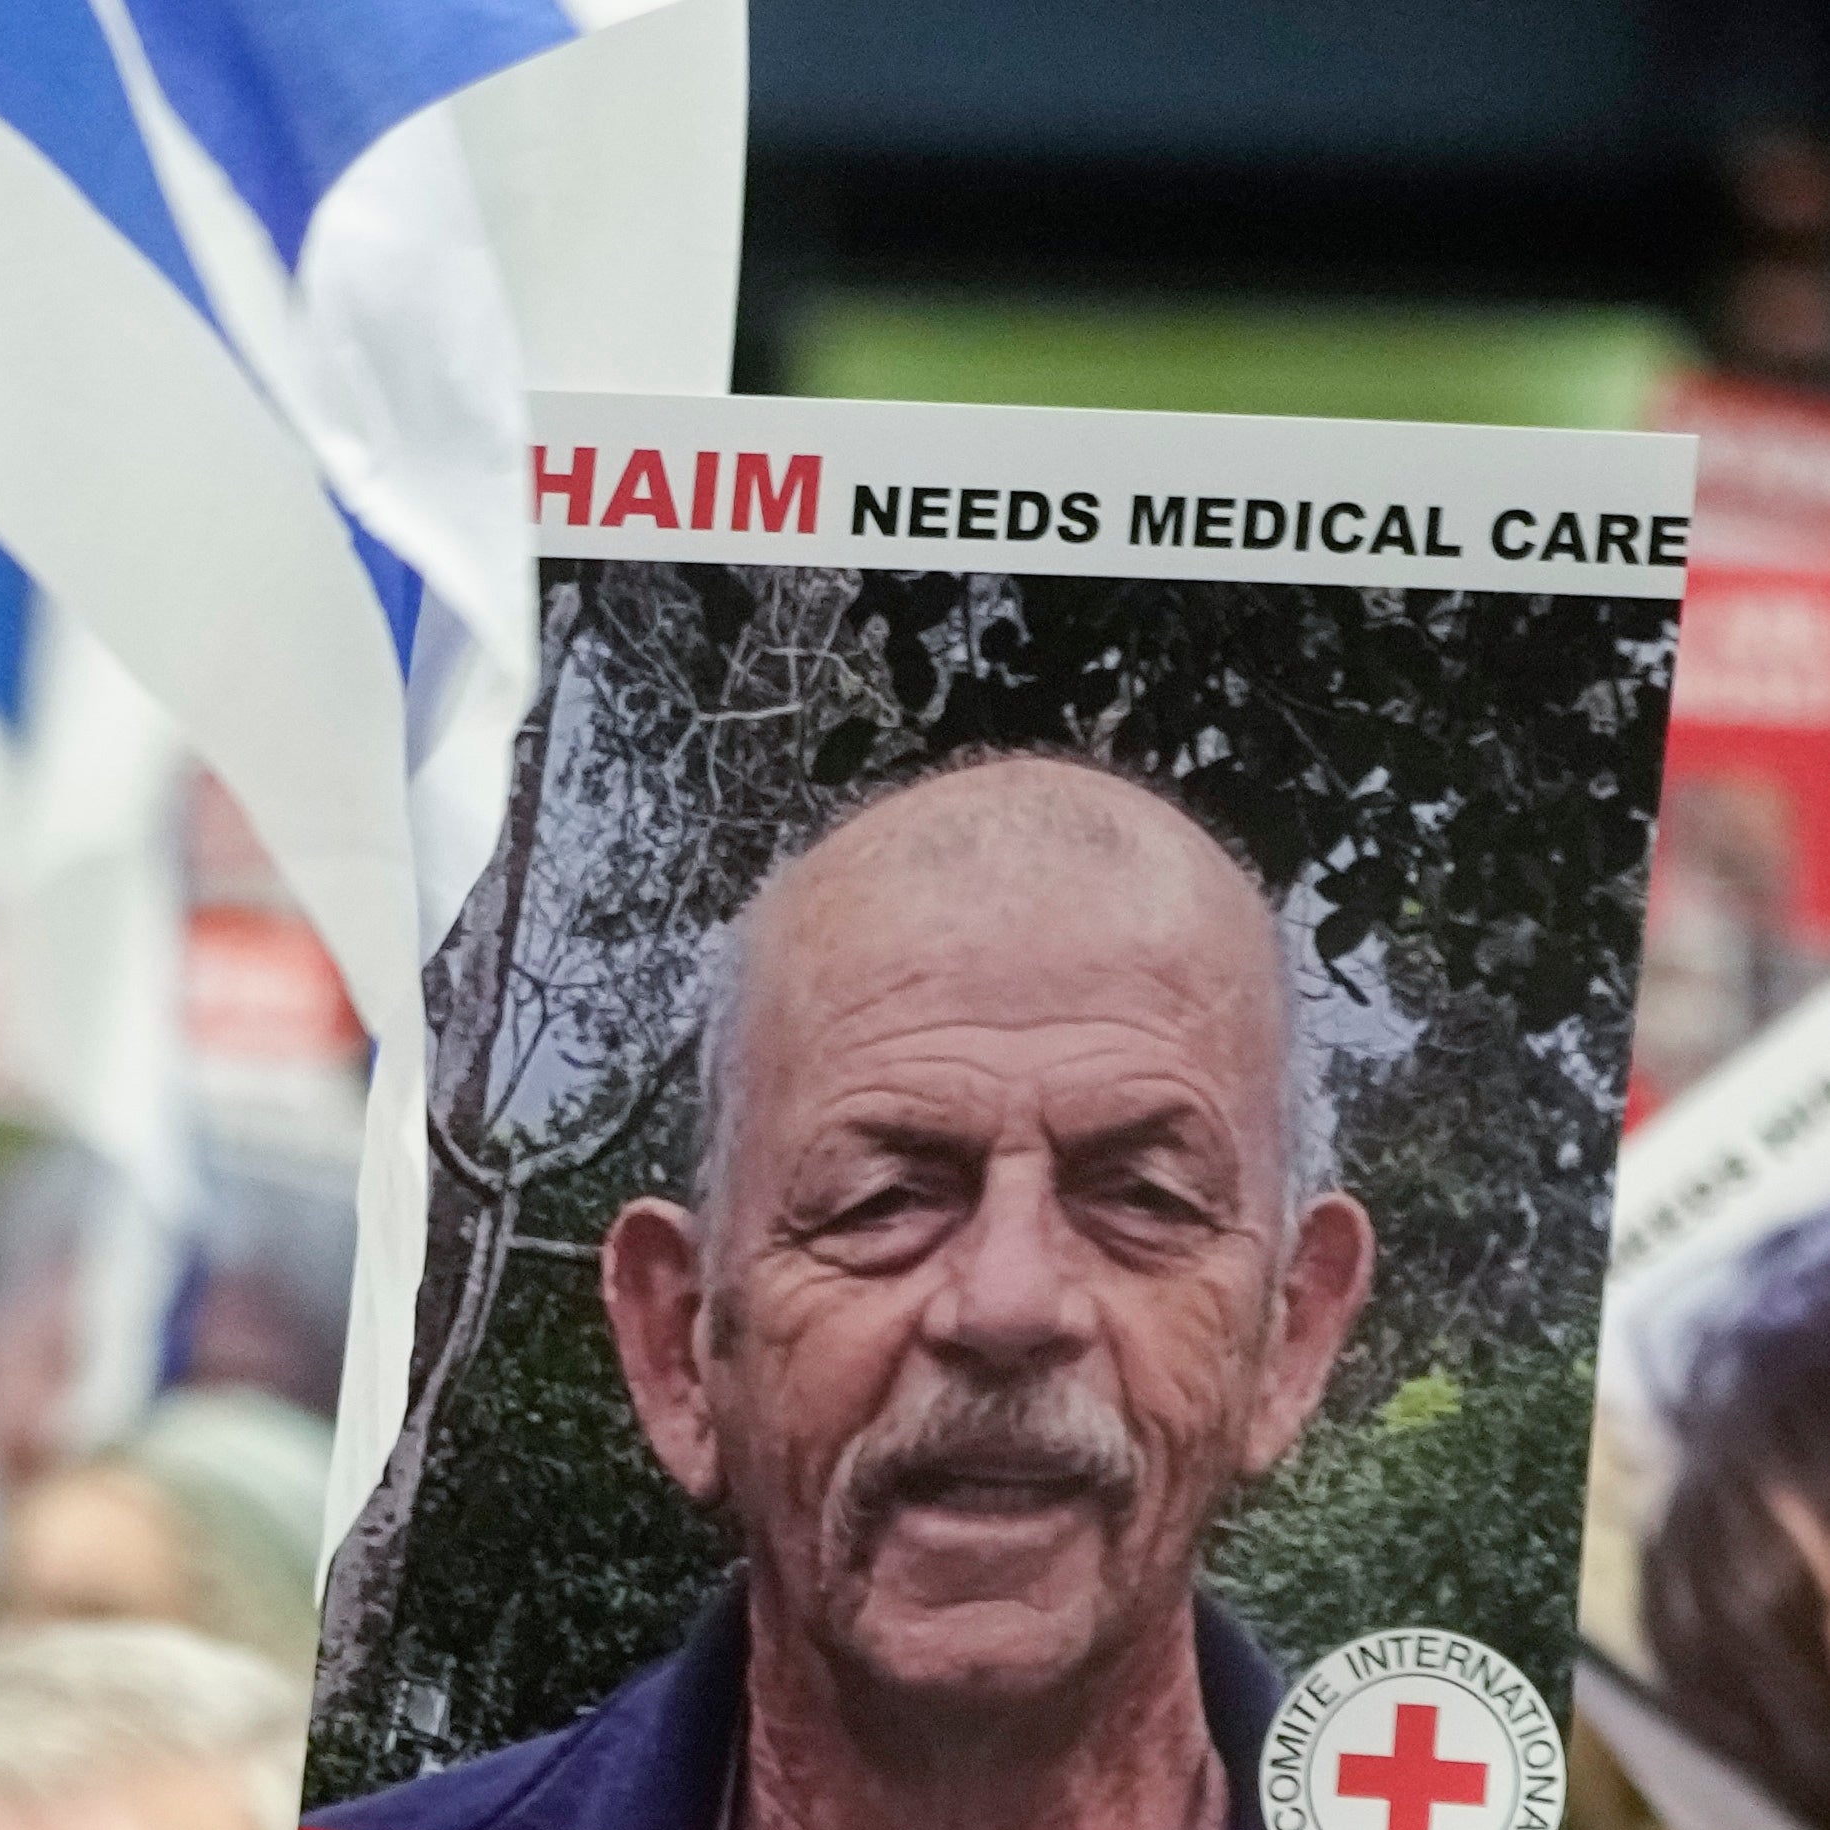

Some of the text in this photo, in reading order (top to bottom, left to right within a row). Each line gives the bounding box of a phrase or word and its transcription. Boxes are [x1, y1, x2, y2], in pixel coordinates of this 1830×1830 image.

[531, 444, 1691, 569] HAIM NEEDS MEDICAL CARE
